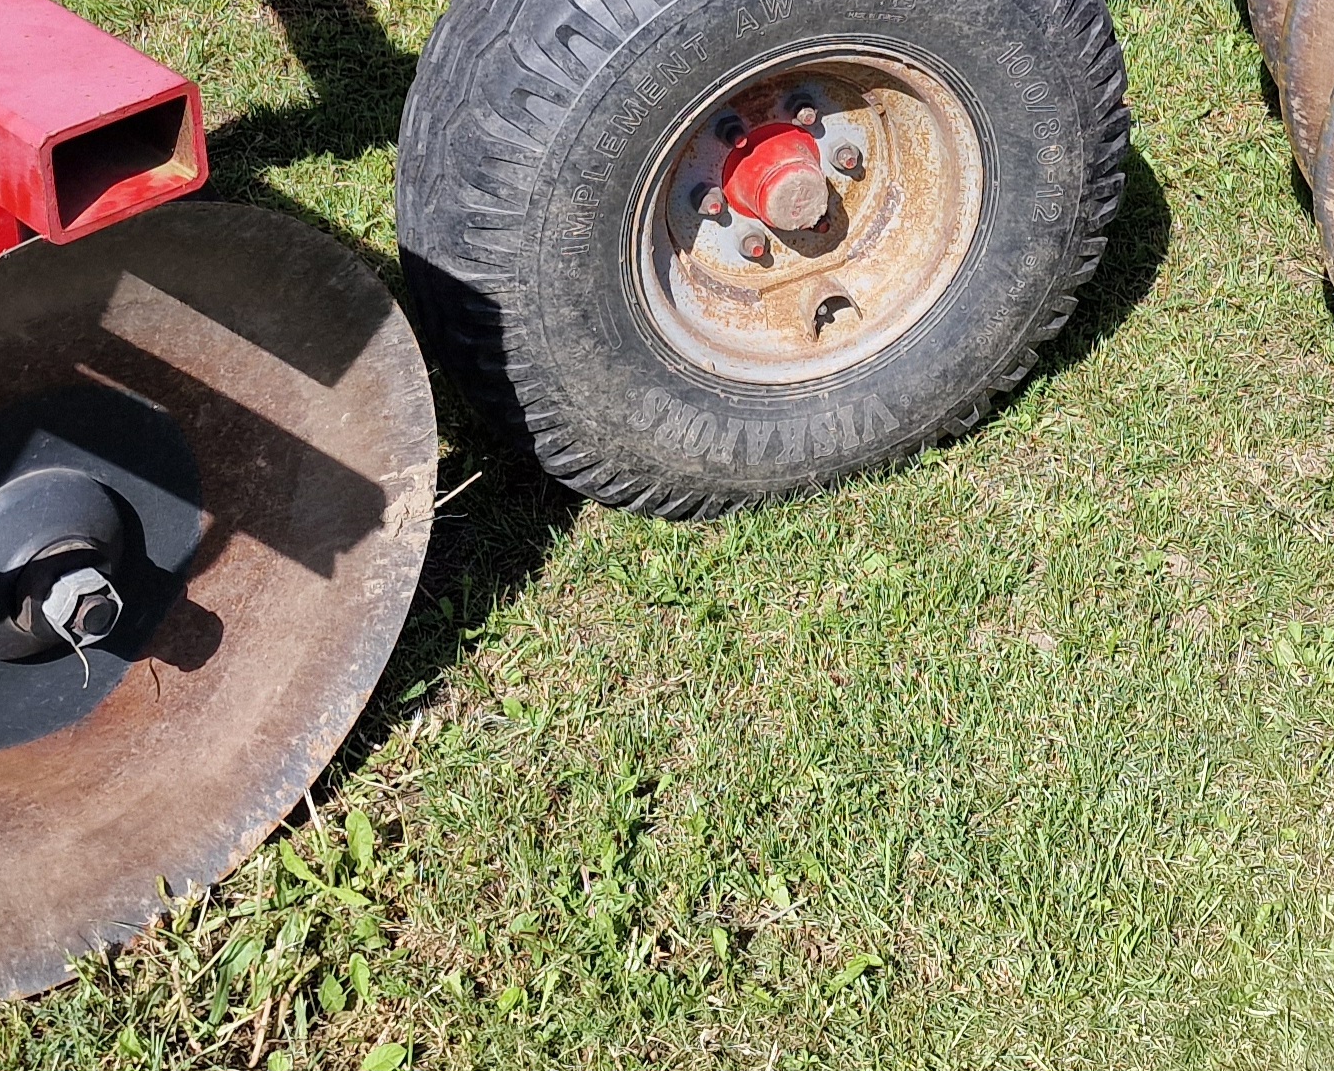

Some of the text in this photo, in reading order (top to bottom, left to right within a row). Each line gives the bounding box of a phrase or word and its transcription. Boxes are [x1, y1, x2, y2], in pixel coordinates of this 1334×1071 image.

[561, 32, 708, 255] IMPLEMENT
[996, 41, 1065, 222] 10.0/80-12
[626, 386, 901, 467] VISKATORS
